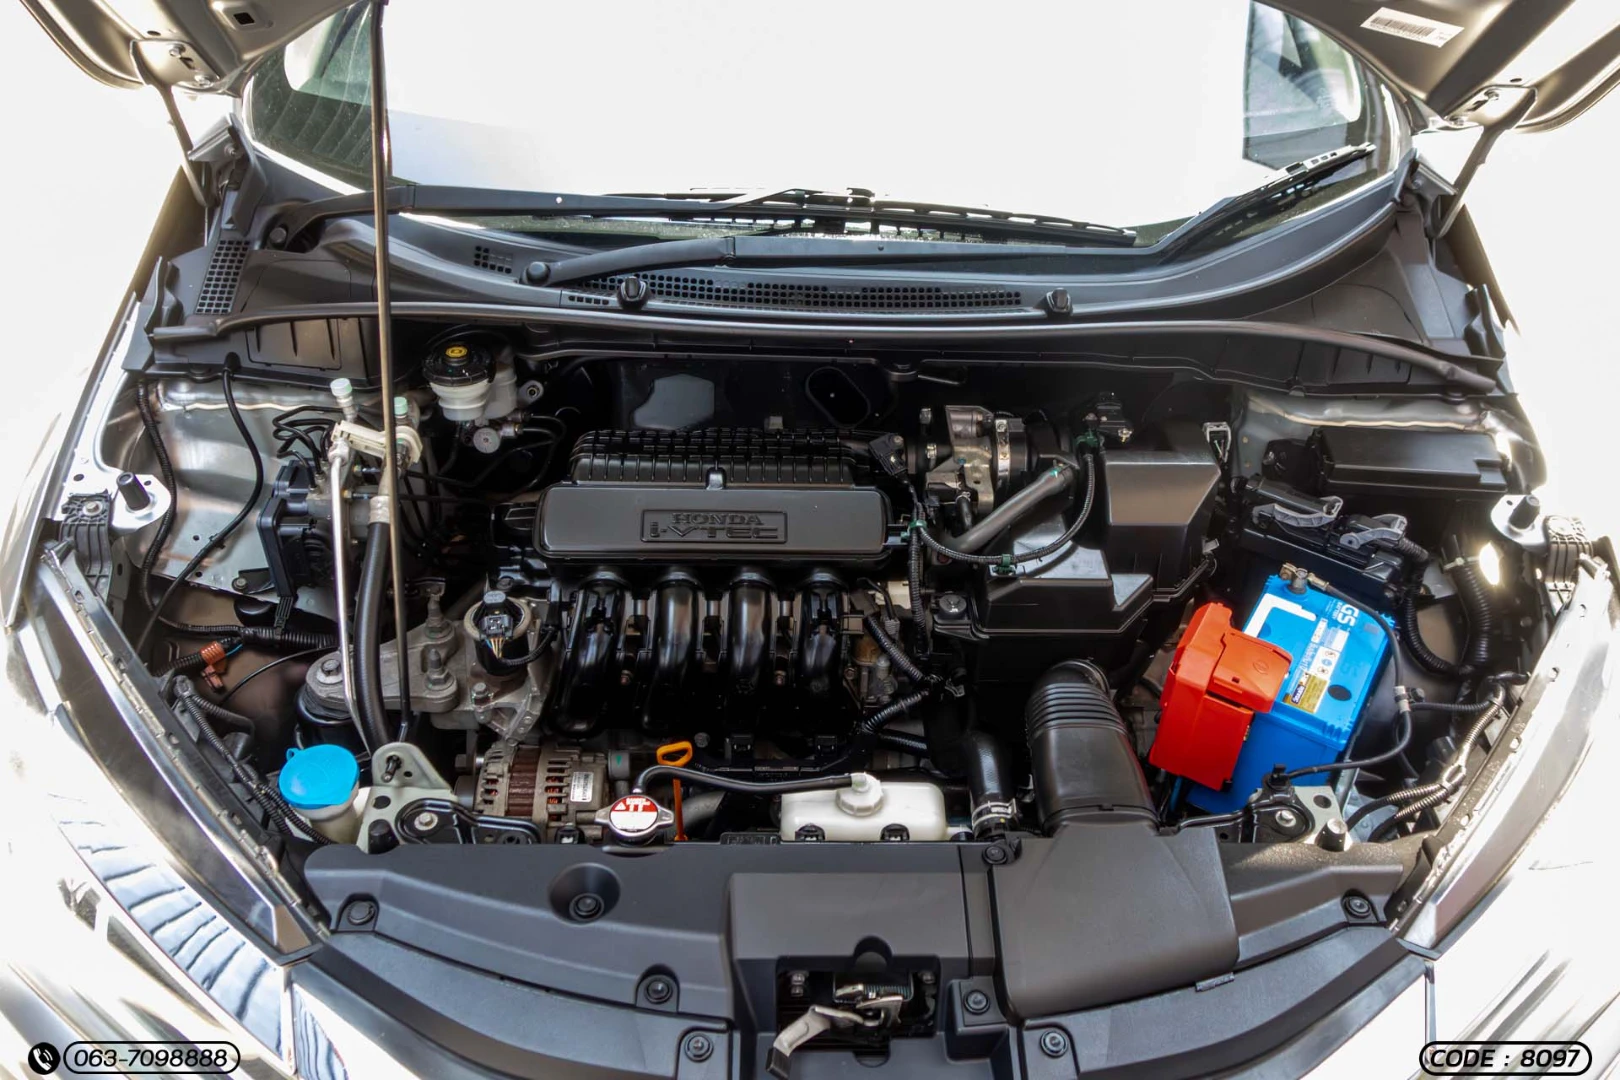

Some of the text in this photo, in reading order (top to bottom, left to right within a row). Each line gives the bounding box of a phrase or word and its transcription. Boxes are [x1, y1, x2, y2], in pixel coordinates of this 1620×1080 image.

[671, 512, 764, 526] HONDA
[650, 521, 779, 539] i-VTEC
[1337, 604, 1359, 626] GS
